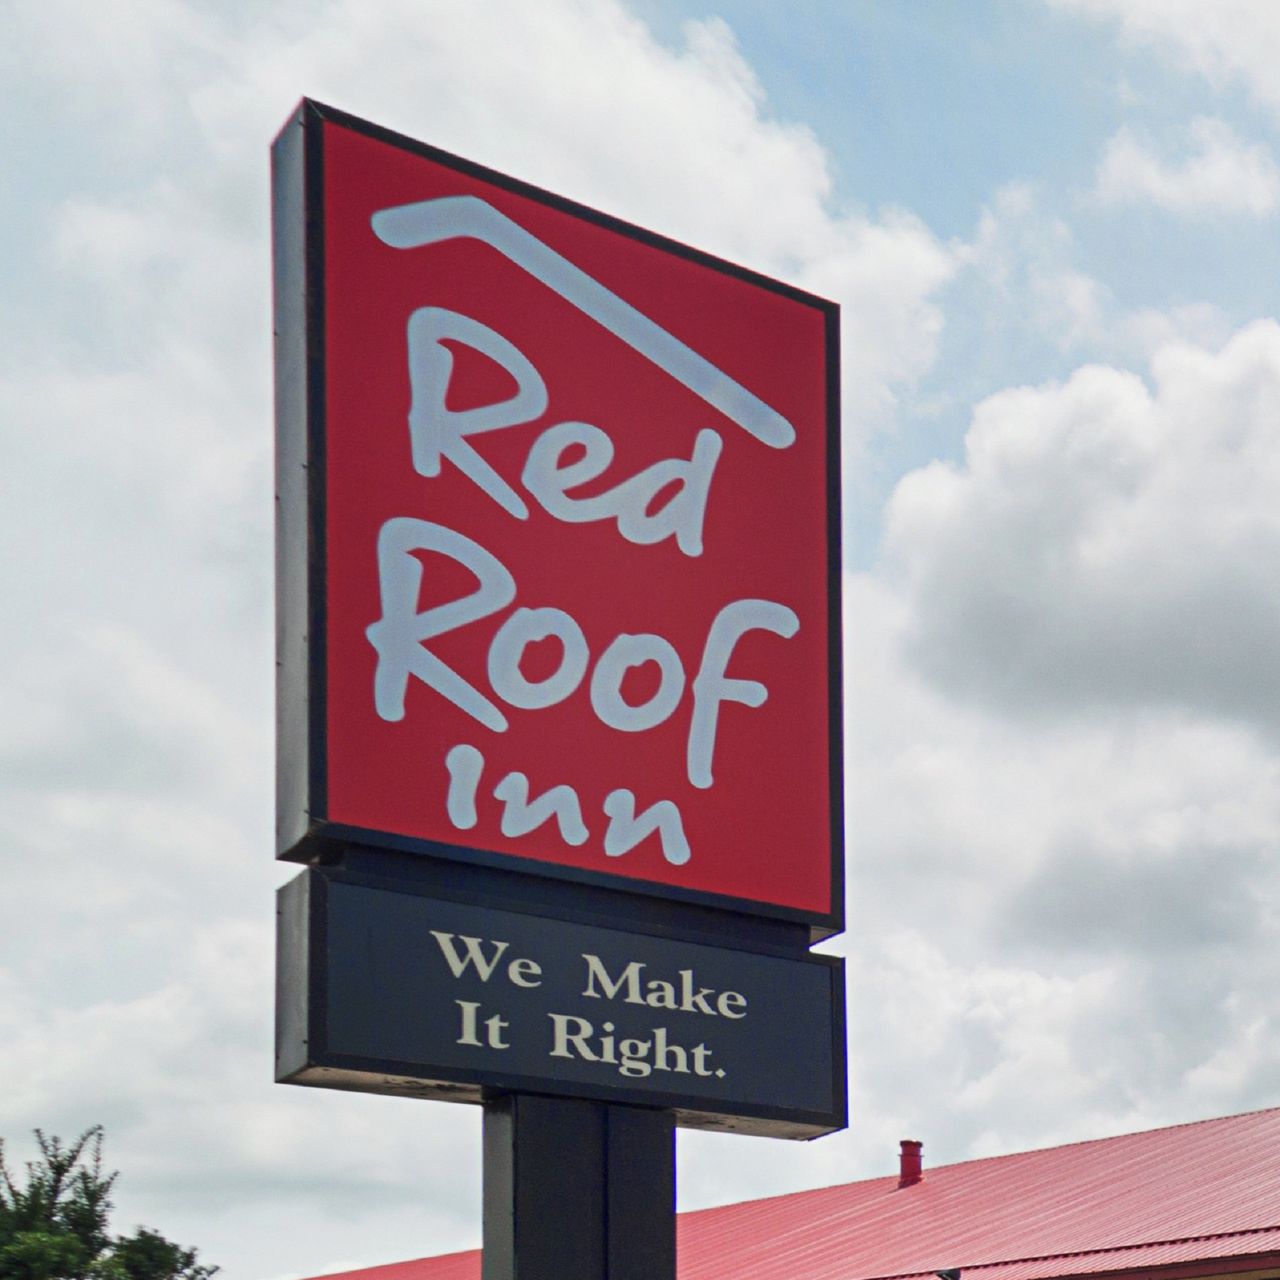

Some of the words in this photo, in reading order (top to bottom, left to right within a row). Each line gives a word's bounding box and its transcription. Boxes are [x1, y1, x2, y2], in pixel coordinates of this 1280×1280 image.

[408, 305, 723, 557] Red
[365, 515, 800, 789] Roof
[429, 930, 543, 988] We
[581, 953, 748, 1020] Make
[455, 999, 511, 1049] It
[547, 1012, 727, 1079] Right.
